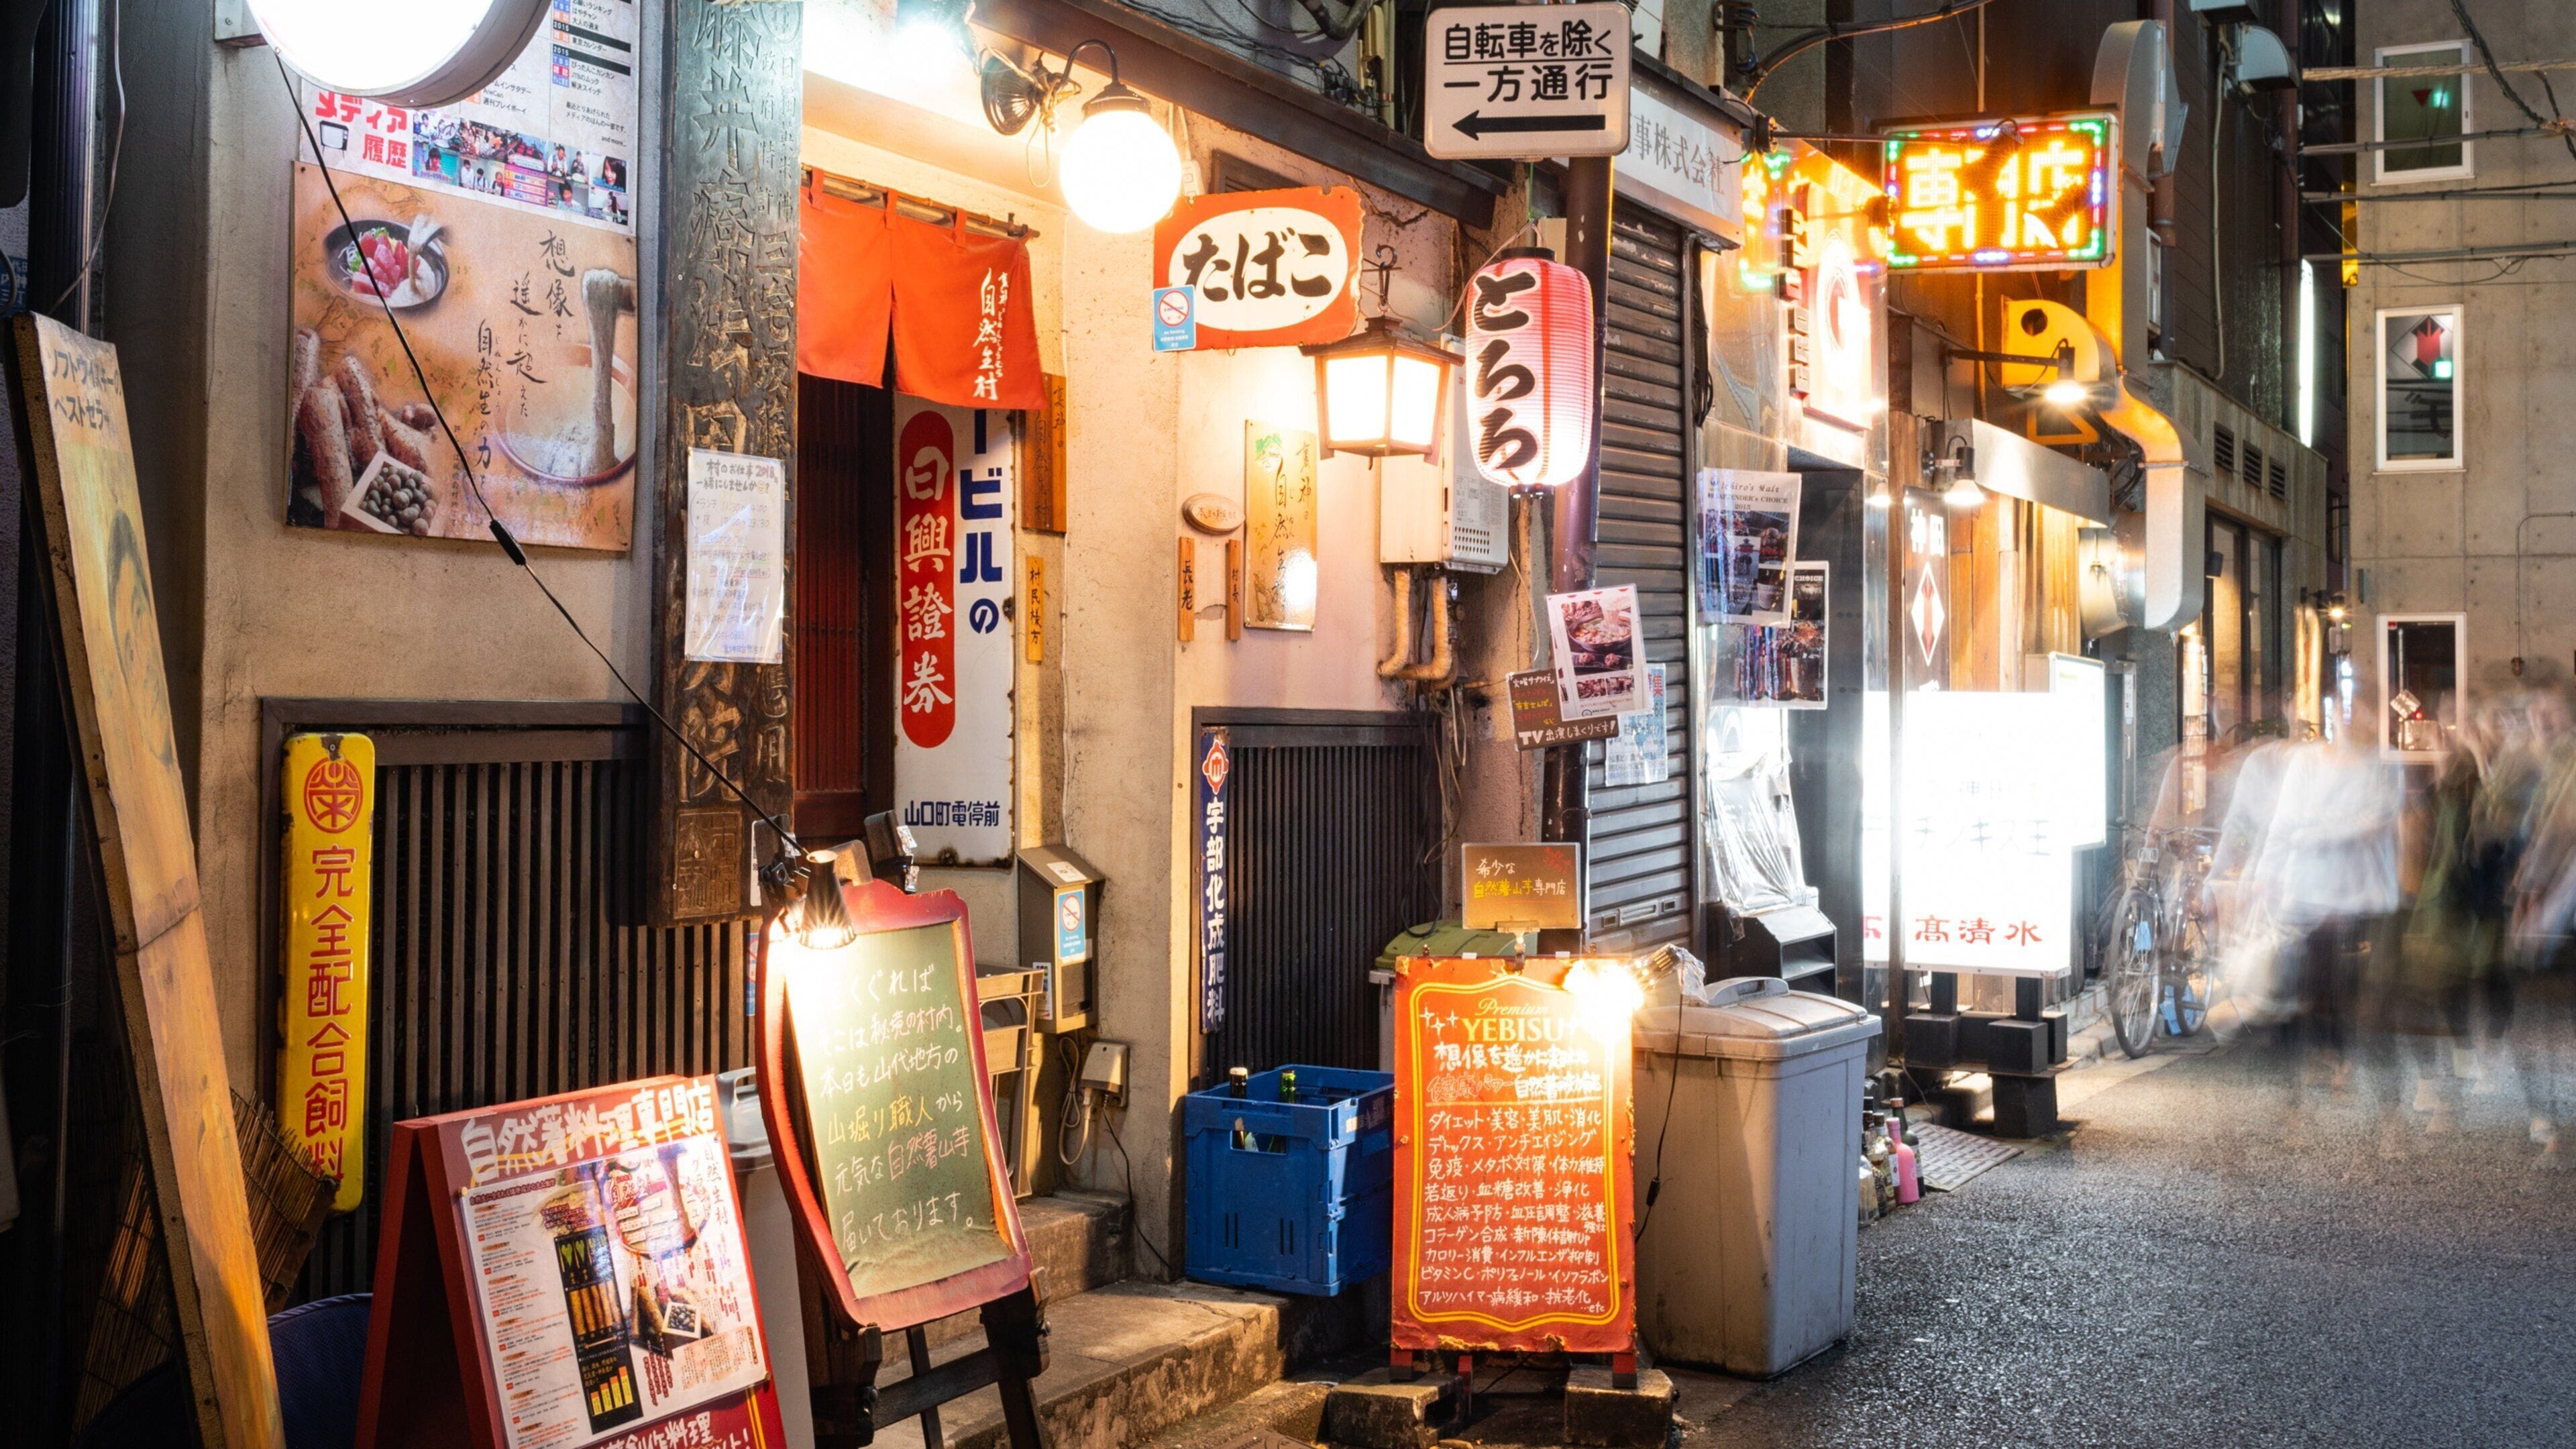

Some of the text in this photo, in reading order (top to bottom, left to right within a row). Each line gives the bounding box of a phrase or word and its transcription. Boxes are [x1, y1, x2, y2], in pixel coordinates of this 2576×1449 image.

[553, 21, 569, 32] 2015
[572, 37, 607, 52] 東京カレンダー
[1445, 19, 1612, 59] 自転車を除く
[553, 46, 569, 56] 2015
[571, 81, 602, 96] 解決スイッチ
[1444, 63, 1613, 102] 一方通行
[315, 92, 407, 133] メディア
[483, 97, 526, 114] 週刊プレイボーイ
[566, 101, 610, 120] 最近とりあげられた
[566, 111, 627, 133] メディアのほんの一部です。
[362, 133, 407, 169] 履歴
[1629, 112, 1725, 196] 事株式会社
[1183, 227, 1332, 302] たばこ
[539, 229, 576, 341] 想像を
[506, 271, 547, 417] 遥かに超えた
[973, 267, 998, 400] 自然生村
[1474, 271, 1538, 470] とろろ
[54, 395, 110, 431] ベストセラー
[904, 445, 953, 714] 日興證券
[1181, 559, 1193, 611] 長老
[1029, 566, 1041, 645] 村民様方
[904, 800, 1000, 828] 山口町電停前
[1477, 858, 1515, 878] 希少な
[1473, 877, 1566, 899] 自然薯山芋専門店
[1205, 796, 1224, 1024] 宇部化成肥料
[305, 844, 354, 1181] 完全配合飼料
[1474, 997, 1548, 1016] Premium
[1461, 1017, 1565, 1042] YEBISU
[820, 1044, 959, 1098] 本日も山代地方の
[460, 1079, 715, 1183] 自然薯料理専門店
[1429, 1107, 1602, 1132] ダイエット・美容・美肌・消化
[1429, 1128, 1597, 1156] デトックス・アンチエイジング
[834, 1125, 971, 1197] 元気な自然薯山芋
[1428, 1155, 1605, 1181] 免疫・メタボ対策・体力維持
[1424, 1178, 1591, 1202] 若返り・血糖改善・浄化
[842, 1191, 973, 1253] 届いております。
[1426, 1202, 1605, 1224] 成人病予防・血圧調整・滋養
[1426, 1245, 1600, 1266] カロリー消費・インフルエンザ抑制
[1419, 1286, 1591, 1307] アルツハイマー病緩和・抗老化
